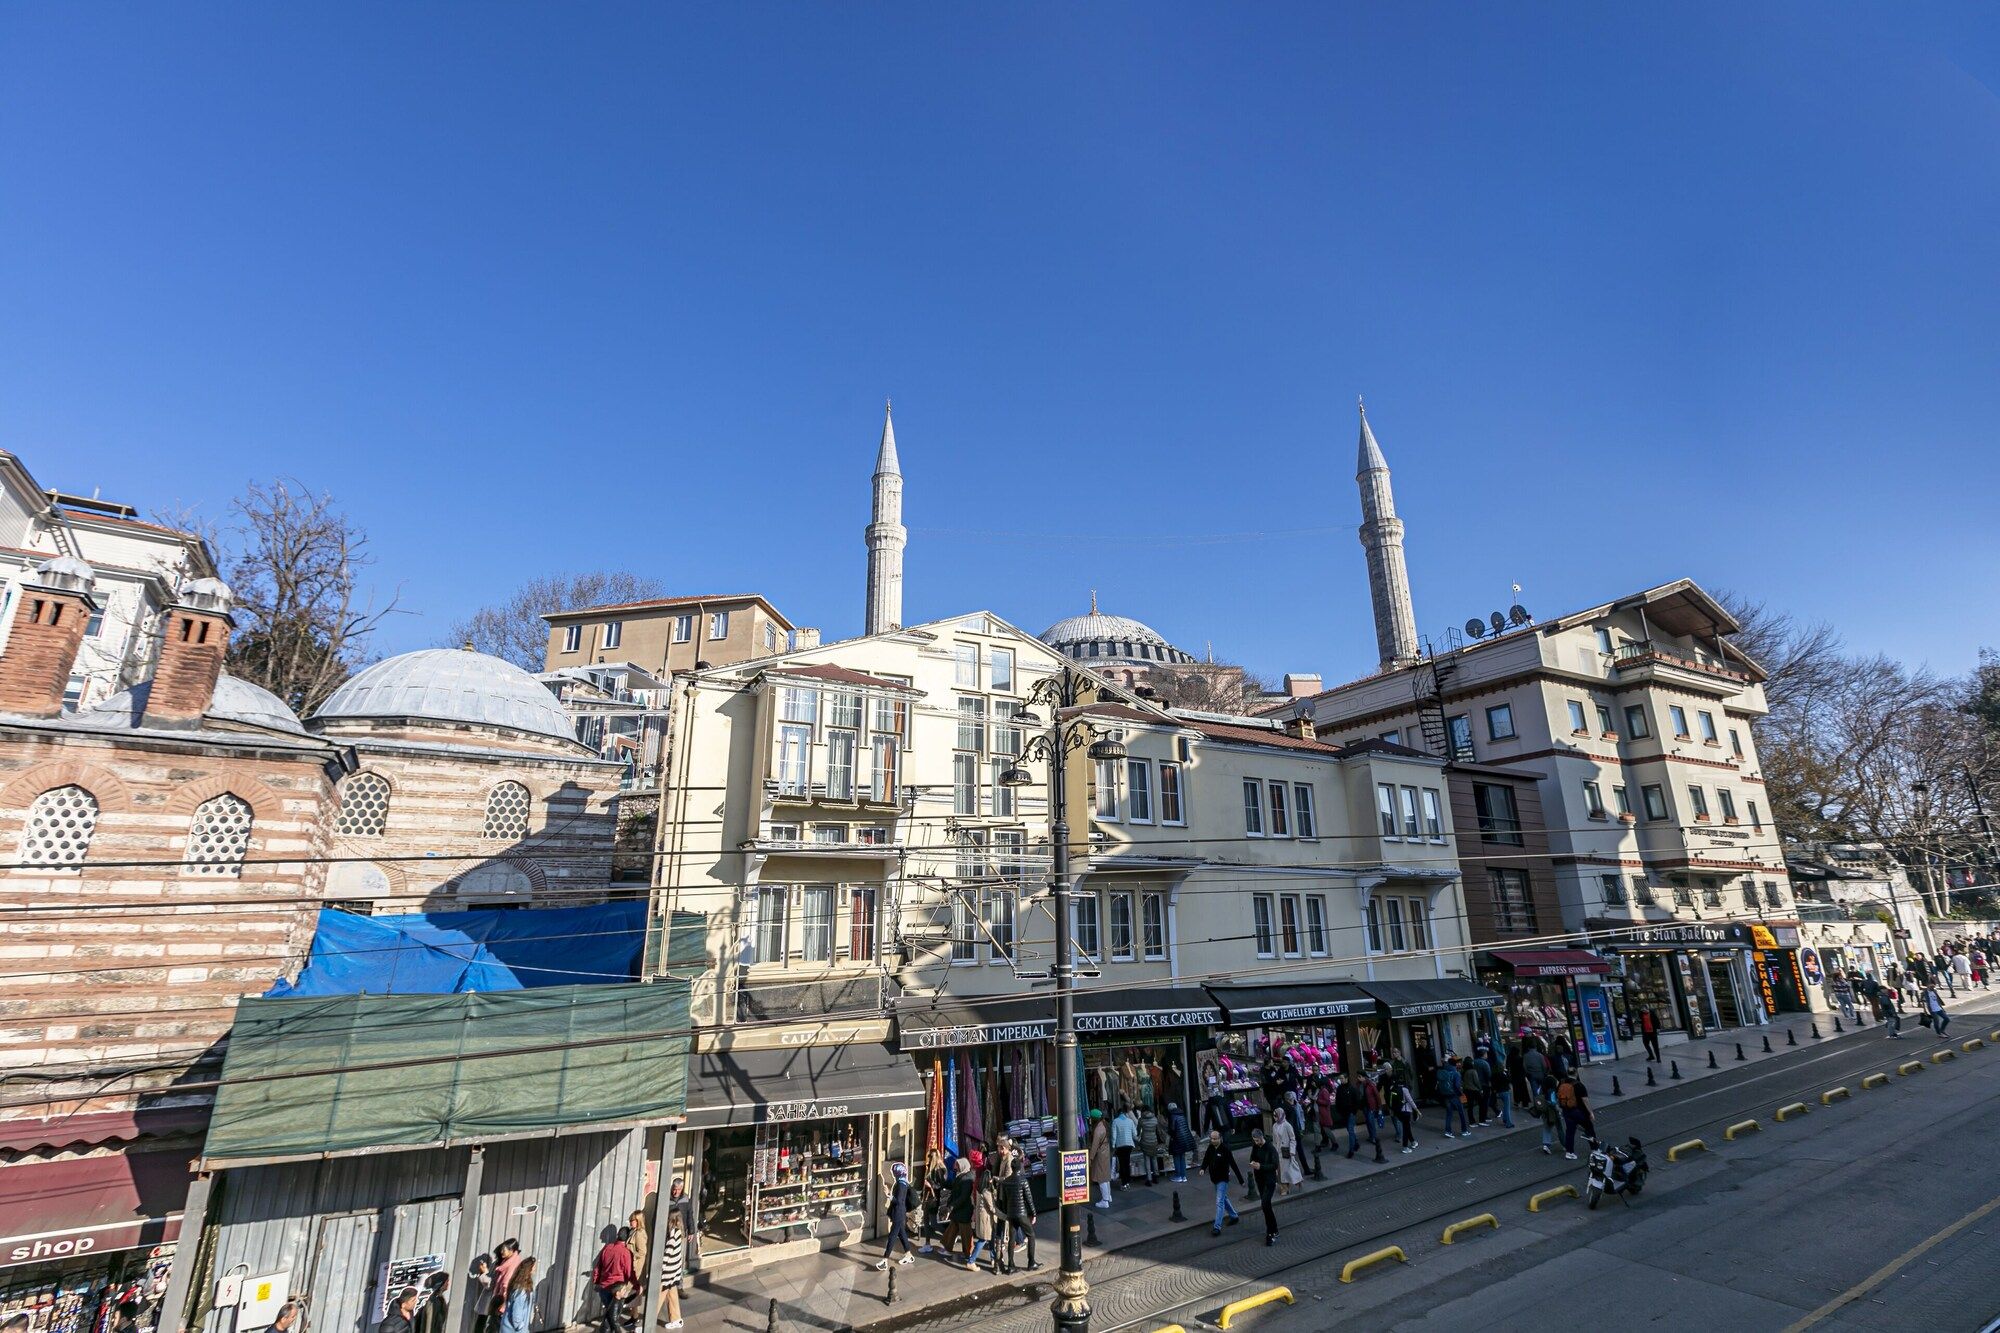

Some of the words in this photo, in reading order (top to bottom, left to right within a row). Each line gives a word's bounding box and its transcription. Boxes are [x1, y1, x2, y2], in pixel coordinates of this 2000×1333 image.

[1680, 925, 1726, 941] Baklava
[1538, 965, 1567, 975] EMPRESS
[1758, 963, 1776, 1013] CHANGE
[1261, 1010, 1279, 1020] CKM
[1280, 1007, 1317, 1019] JEWELLERY
[1319, 1007, 1325, 1015] &
[1326, 1004, 1350, 1014] SILVER
[1469, 1000, 1478, 1008] ICE
[1477, 999, 1495, 1007] CREAM
[1077, 1017, 1103, 1030] CKM
[1106, 1015, 1129, 1028] FINE
[1131, 1014, 1157, 1027] ARTS
[1159, 1015, 1169, 1025] &
[1170, 1011, 1214, 1025] CARPETS
[919, 1028, 989, 1048] OTTOMAN
[992, 1024, 1047, 1041] IMPERIAL
[766, 1103, 820, 1122] SAHRA
[822, 1105, 849, 1117] LEDER
[1064, 1163, 1087, 1171] TRAMVAY
[10, 1237, 95, 1261] shop
